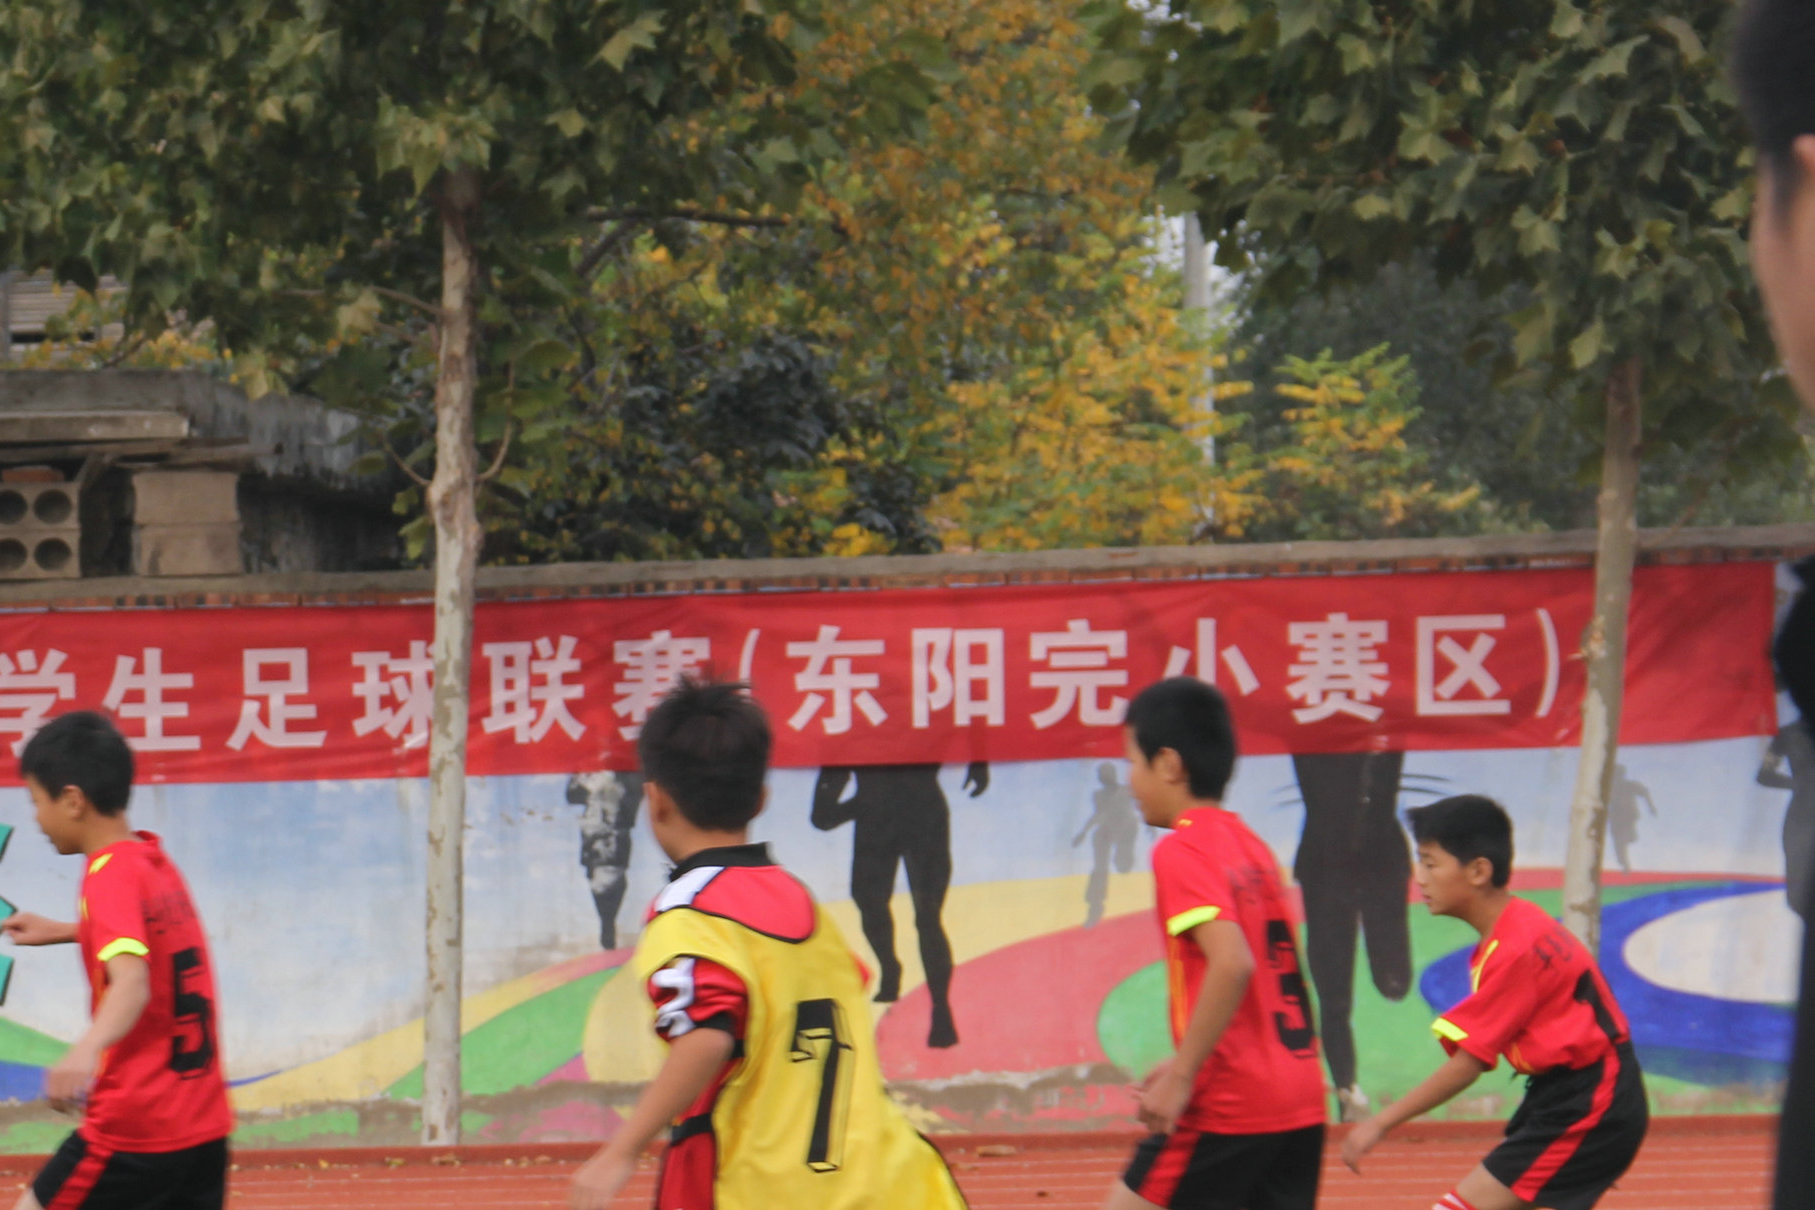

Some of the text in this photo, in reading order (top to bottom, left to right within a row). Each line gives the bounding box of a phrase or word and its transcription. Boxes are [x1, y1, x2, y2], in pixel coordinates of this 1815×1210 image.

[169, 946, 216, 1080] 5
[1266, 919, 1320, 1059] 3
[790, 998, 856, 1172] 7
